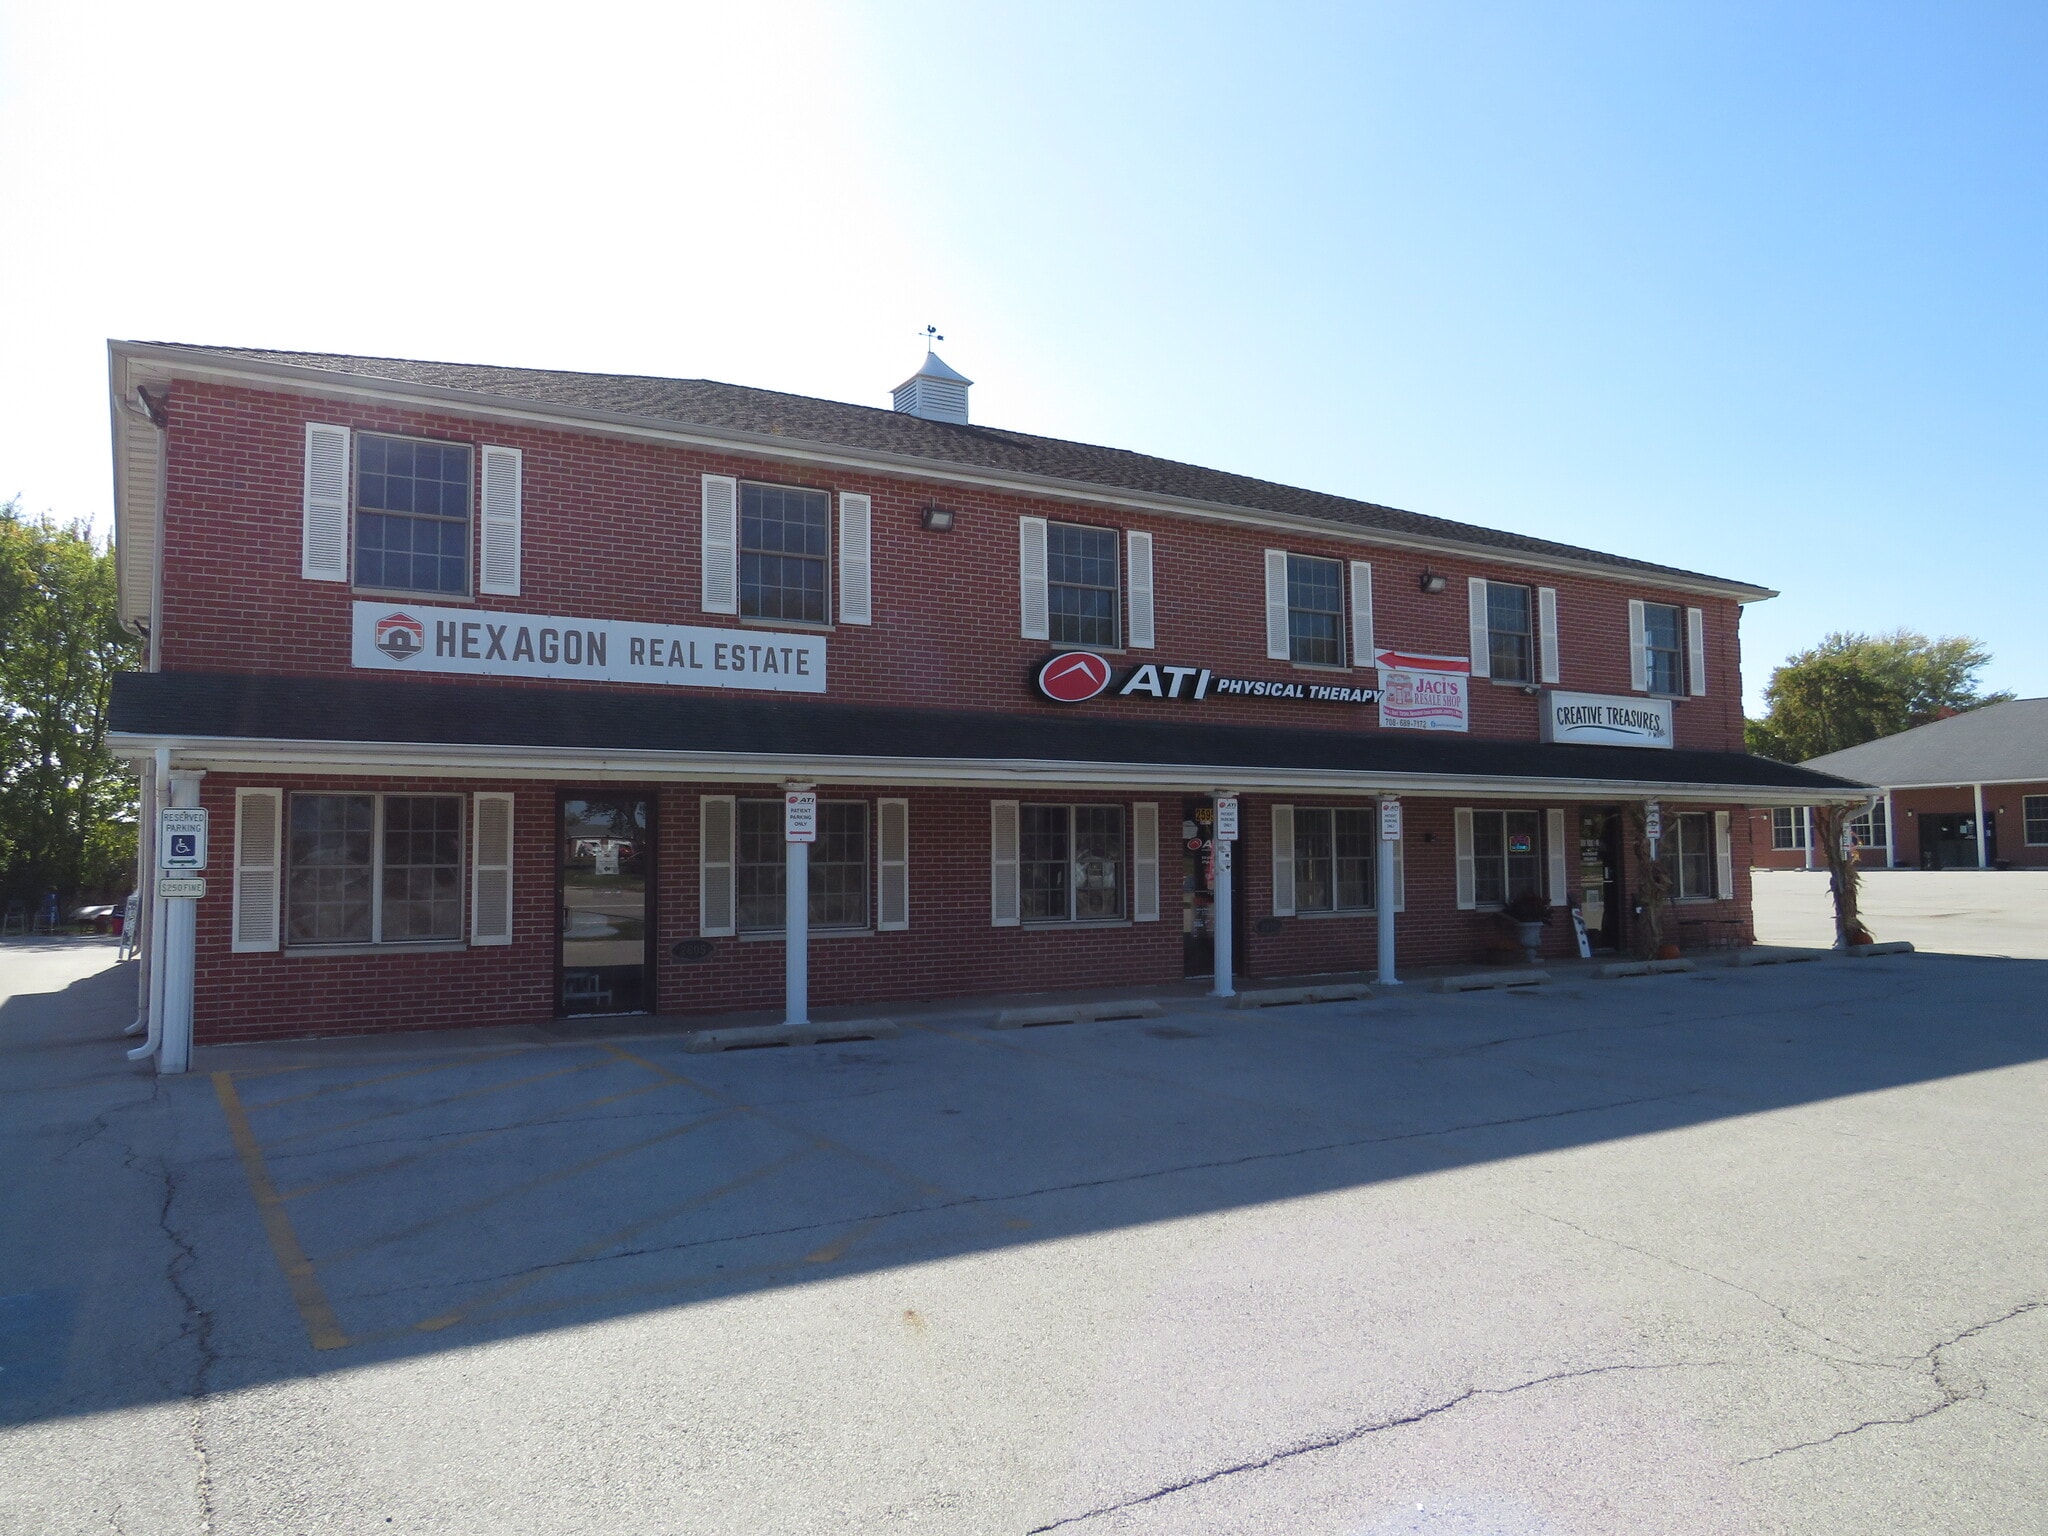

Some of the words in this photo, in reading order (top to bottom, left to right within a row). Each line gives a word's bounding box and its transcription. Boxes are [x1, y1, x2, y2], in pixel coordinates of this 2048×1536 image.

[436, 620, 607, 667] HEXAGON
[630, 637, 703, 669] REAL
[714, 642, 810, 675] ESTATE
[1119, 664, 1211, 700] ATI
[1217, 678, 1304, 699] PHYSICAL
[1308, 685, 1386, 703] THERAPY
[1414, 692, 1441, 706] RESALE
[1442, 695, 1461, 708] SHOP
[1556, 706, 1602, 725] CREATIVE
[1606, 707, 1660, 732] TREASURES
[163, 813, 204, 822] RESERVED
[166, 824, 201, 833] PARKING
[183, 884, 202, 892] FINE
